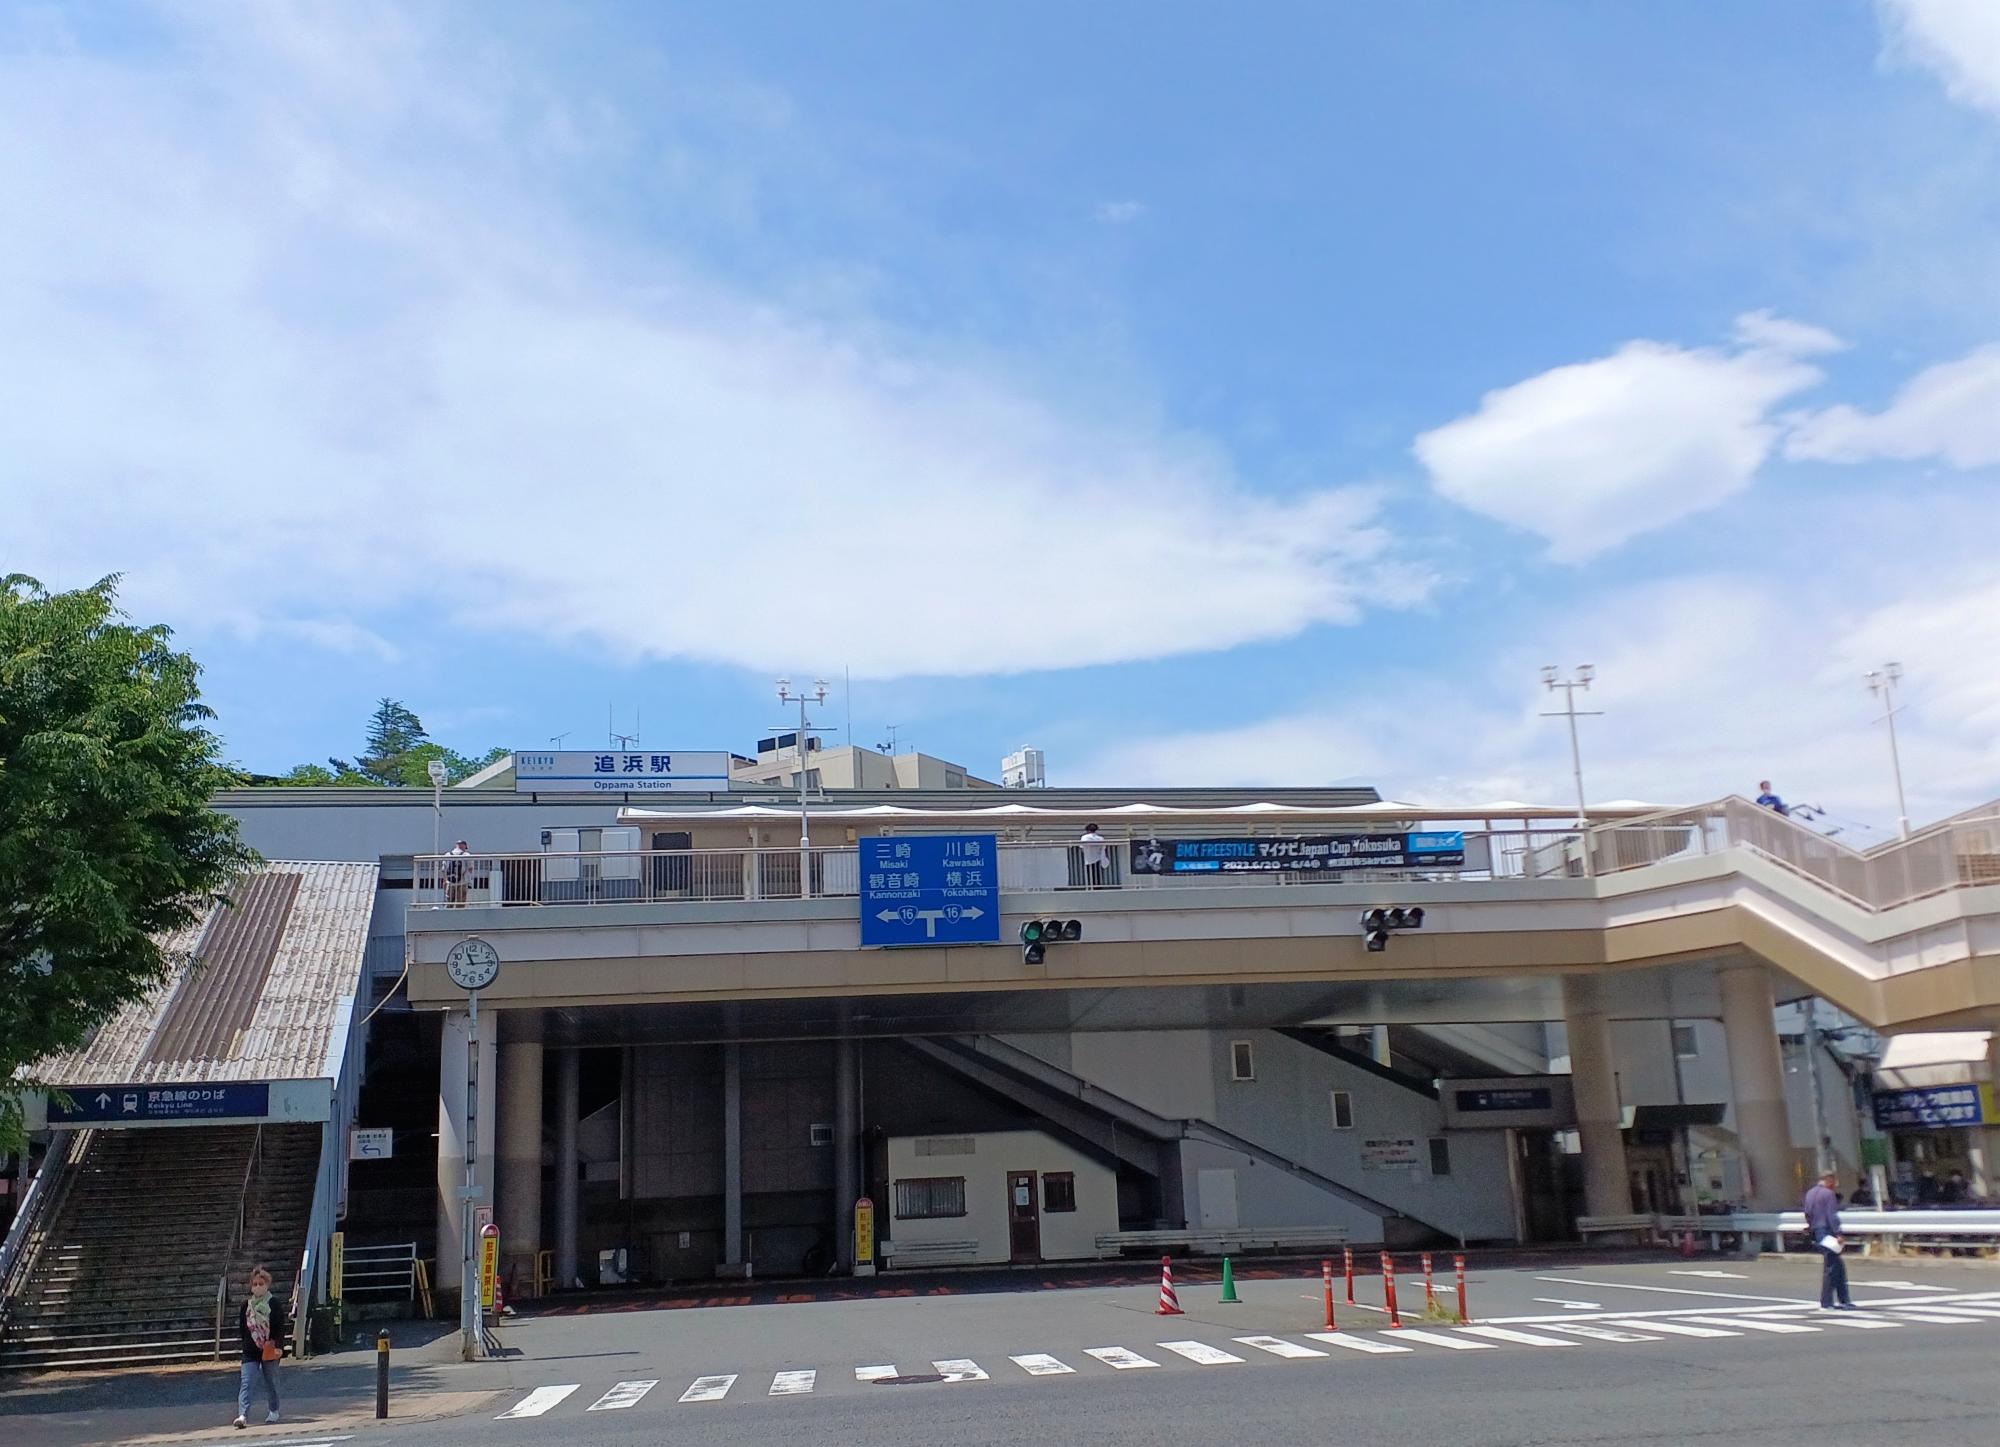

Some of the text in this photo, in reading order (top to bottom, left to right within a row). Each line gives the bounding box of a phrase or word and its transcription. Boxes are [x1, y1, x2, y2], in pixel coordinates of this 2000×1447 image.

[594, 755, 671, 773] 追浜駅
[594, 781, 672, 791] Oppama Station
[876, 843, 911, 858] 三崎
[945, 841, 980, 857] 川崎
[1176, 843, 1200, 857] BMX
[1201, 842, 1255, 857] FREESTYLE
[1258, 842, 1299, 857] マイナビ
[1300, 842, 1329, 856] Japan
[1329, 840, 1350, 856] Cup
[1353, 837, 1401, 854] Yokosuka
[880, 860, 908, 869] Misaki
[942, 858, 985, 867] Kawasaki
[869, 872, 919, 889] 観音崎
[946, 871, 982, 887] 横浜
[869, 890, 921, 899] Kannonzaki
[942, 888, 988, 897] Yokohama
[901, 908, 913, 920] 16
[946, 906, 958, 918] 16
[148, 1089, 226, 1102] 京急線のりば
[483, 1241, 495, 1297] 駐停車禁止
